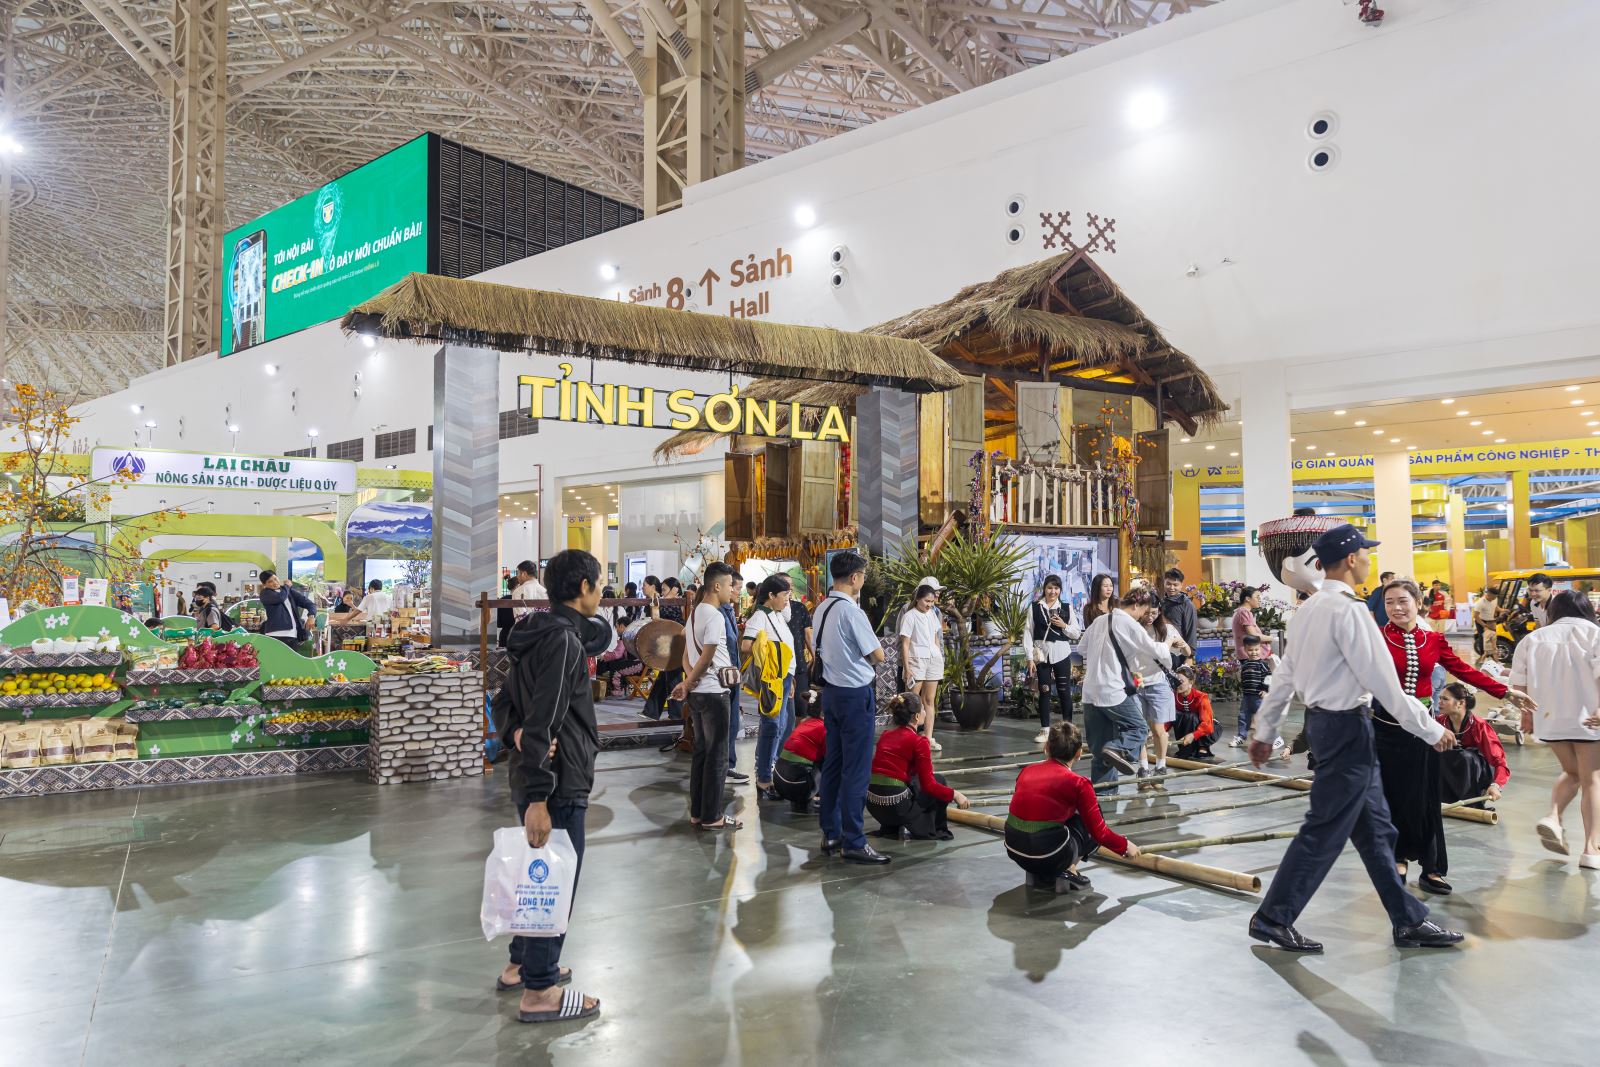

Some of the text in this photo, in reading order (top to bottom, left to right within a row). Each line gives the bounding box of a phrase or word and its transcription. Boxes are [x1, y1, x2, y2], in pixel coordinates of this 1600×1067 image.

[271, 256, 325, 293] CHECK-IN
[336, 248, 355, 269] ĐÂY
[372, 226, 402, 254] CHUẨN
[404, 221, 423, 242] BÀI!
[286, 243, 300, 260] NỘI
[300, 237, 315, 255] BÀI
[730, 247, 793, 288] Sảnh
[628, 282, 662, 304] Sảnh
[666, 276, 684, 311] 8
[730, 291, 769, 319] Hall
[517, 363, 850, 443] TỈNH SƠN LA
[203, 457, 291, 473] LAI CHÂU
[1306, 459, 1336, 469] GIAN
[1409, 452, 1433, 465] SẢN
[1436, 449, 1474, 463] PHẨM
[1477, 449, 1516, 461] CÔNG
[1520, 447, 1570, 461] NGHIỆP
[155, 471, 188, 484] NÔNG
[191, 471, 214, 485] SẢN
[217, 474, 248, 488] SẠCH
[257, 476, 287, 491] DƯỢC
[290, 477, 312, 492] LIỆU
[518, 897, 538, 906] LONG
